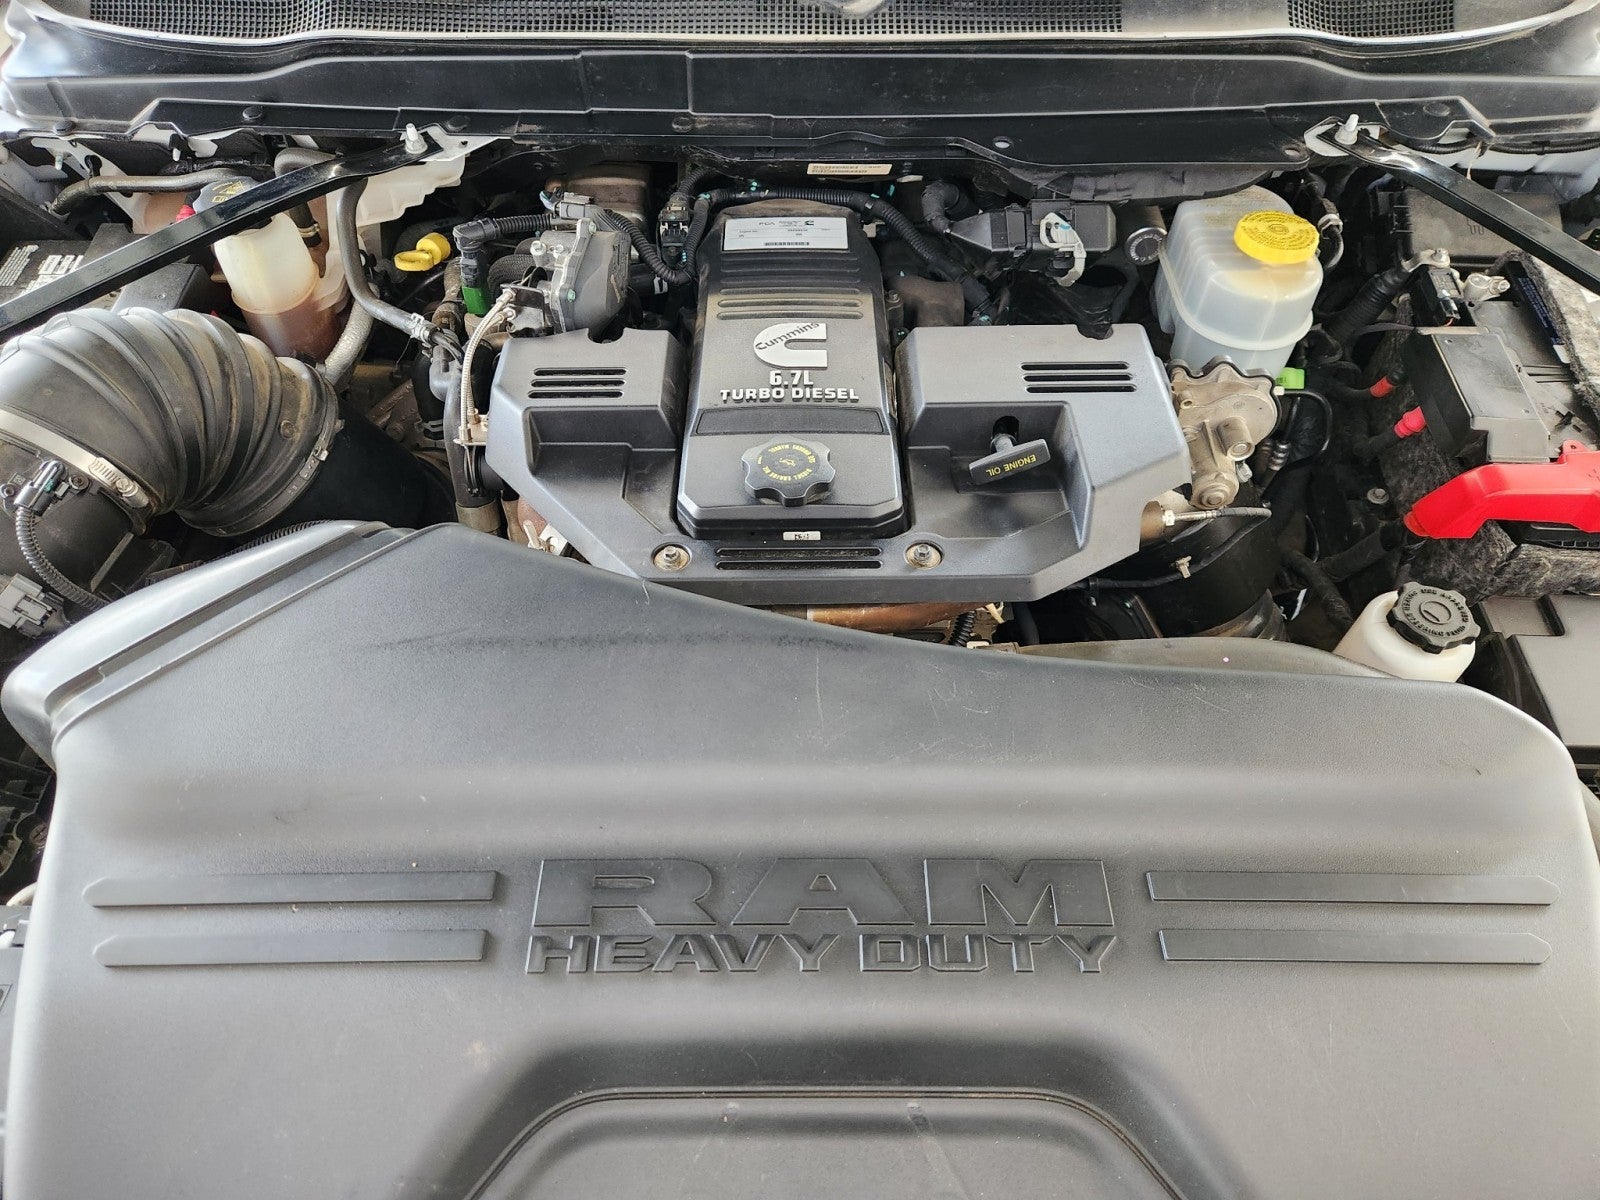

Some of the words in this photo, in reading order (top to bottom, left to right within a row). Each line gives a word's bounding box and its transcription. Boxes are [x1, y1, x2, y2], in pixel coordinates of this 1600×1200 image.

[755, 321, 820, 350] Cummins
[769, 370, 814, 387] 6.7L
[720, 388, 785, 401] TURBO
[791, 387, 859, 401] DIESEL
[986, 467, 1001, 477] OIL
[1003, 454, 1037, 472] ENGINE
[532, 857, 1115, 927] RAM
[525, 933, 840, 974] HEAVY
[858, 933, 1118, 974] DUTY
